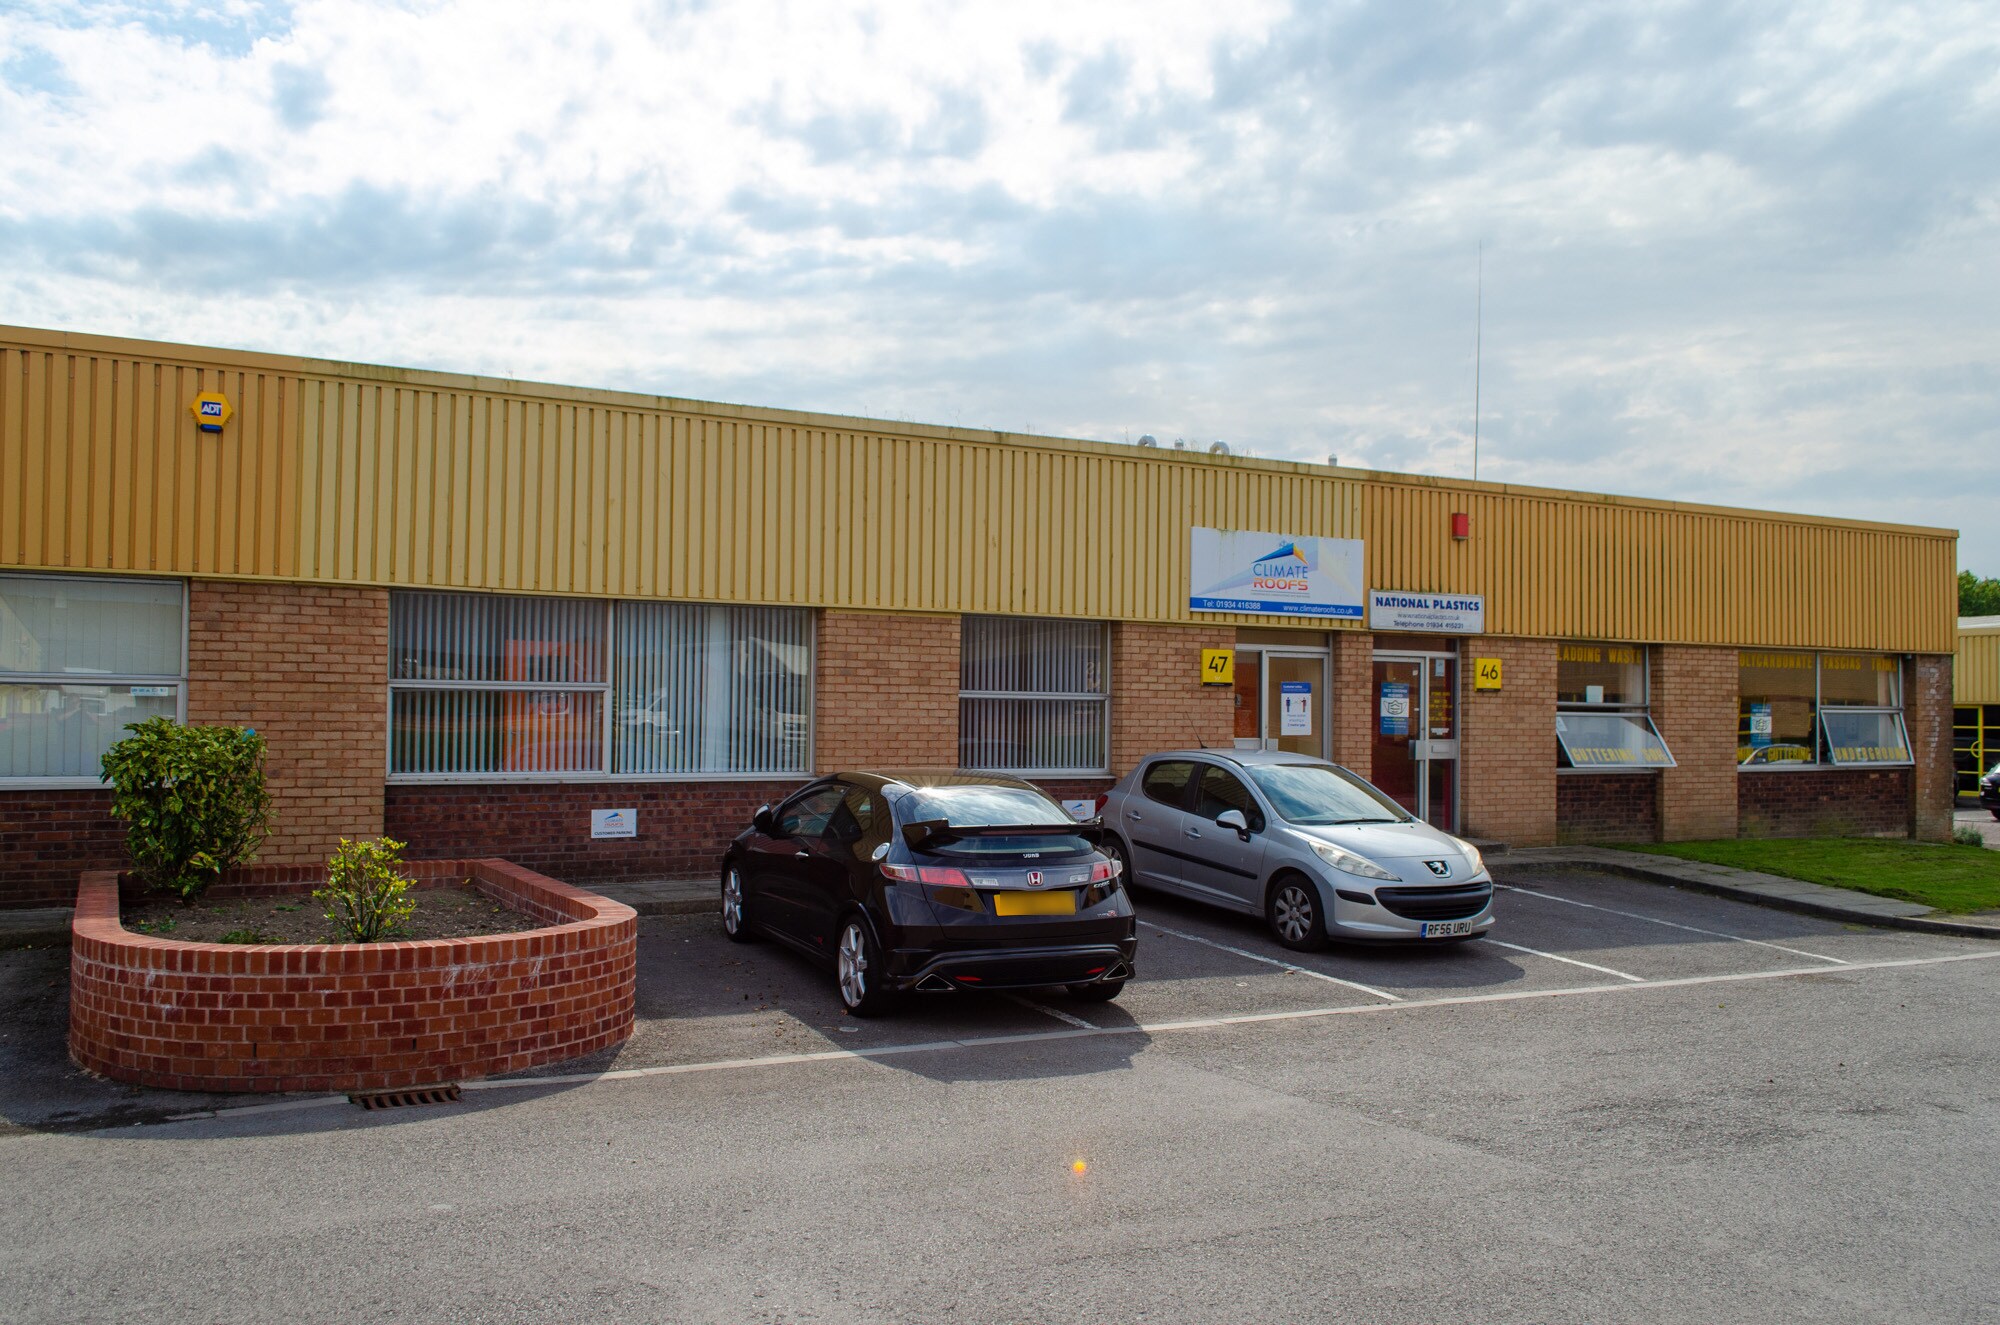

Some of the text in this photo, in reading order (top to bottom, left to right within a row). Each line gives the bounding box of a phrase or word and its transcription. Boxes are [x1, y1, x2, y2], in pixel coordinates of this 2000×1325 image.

[201, 403, 222, 415] ADT
[1252, 563, 1309, 579] CLIMATE
[1253, 578, 1309, 591] ROOFS
[1202, 599, 1214, 608] Tel:
[1216, 601, 1236, 609] 01934
[1283, 604, 1354, 615] www.climateroofs.co.uk
[1375, 596, 1480, 612] NATIONAL PLASTICS
[1393, 620, 1425, 629] Telephone
[1556, 644, 1601, 662] LADDING
[1739, 651, 1813, 669] OLYCARBONATE
[1823, 655, 1862, 670] FASCIAS
[1208, 656, 1229, 673] 47
[1480, 664, 1499, 680] 46
[1569, 747, 1637, 765] GUTTERING
[1427, 922, 1471, 936] RF56 URU
